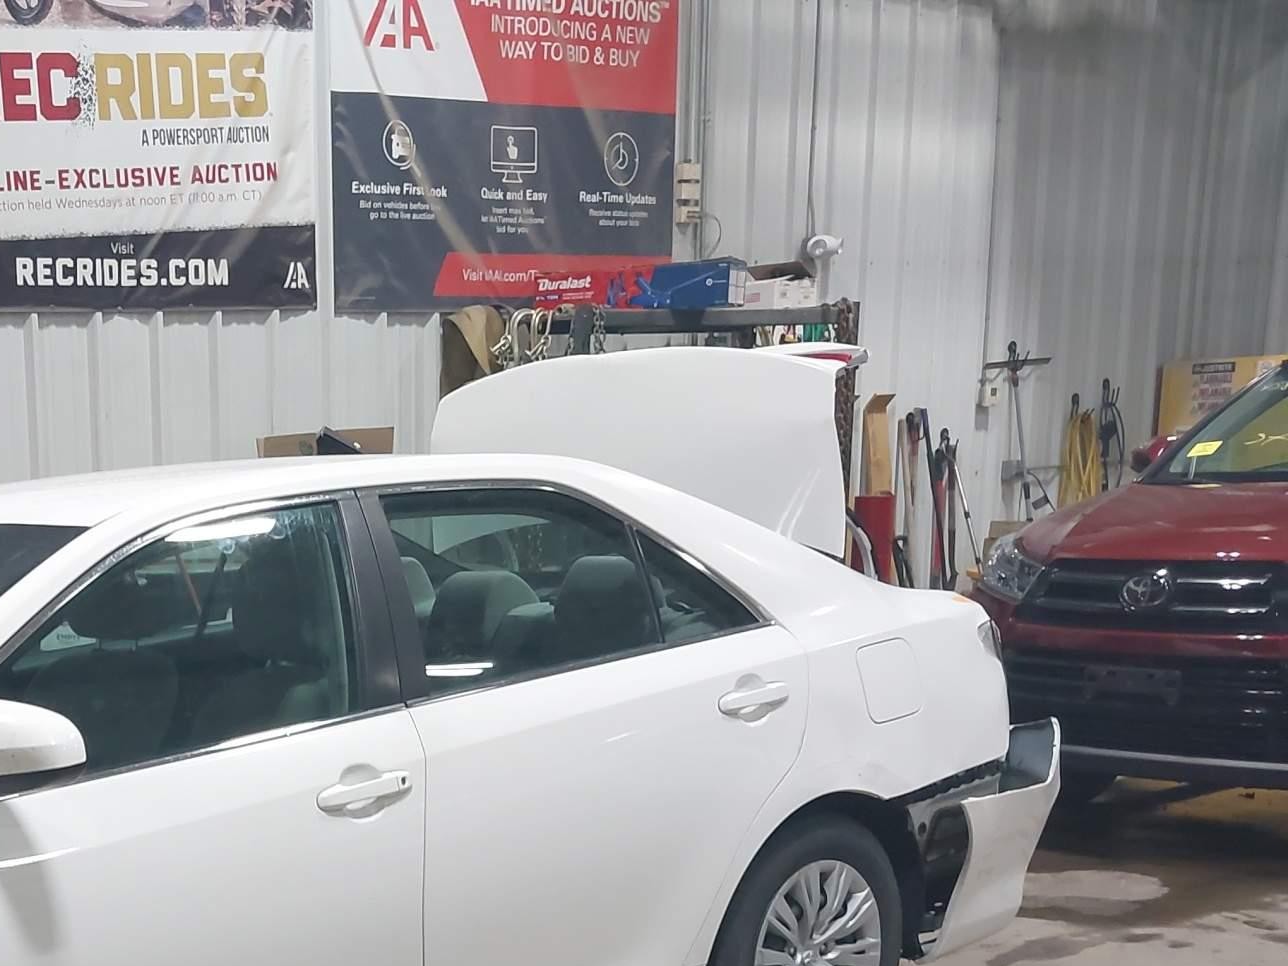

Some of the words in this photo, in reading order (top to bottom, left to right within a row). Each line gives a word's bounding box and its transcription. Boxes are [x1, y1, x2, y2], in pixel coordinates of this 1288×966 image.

[491, 14, 596, 41] INTRODUCING
[601, 25, 612, 42] A
[616, 25, 650, 44] NEW
[500, 40, 537, 59] WAY
[541, 42, 562, 61] TO
[566, 45, 589, 63] BID
[593, 47, 605, 65] &
[609, 48, 640, 67] BUY
[142, 129, 149, 146] A
[153, 126, 225, 146] POWERSPORT
[227, 125, 270, 144] AUCTION
[191, 162, 278, 184] AUCTION
[351, 181, 401, 195] Exclusive
[480, 186, 504, 200] Quick
[506, 189, 523, 200] and
[526, 189, 548, 203] Easy
[28, 198, 52, 210] held
[56, 195, 122, 210] Wednesdays
[126, 196, 136, 207] at
[140, 195, 167, 206] noon
[170, 193, 185, 205] ET
[188, 191, 215, 205] (1100
[243, 190, 262, 202] CT)
[579, 191, 624, 203] Real-Time
[625, 192, 656, 205] Updates
[111, 241, 134, 255] Visit
[15, 257, 229, 287] RECRIDES.COM
[462, 268, 482, 281] Visit
[538, 275, 591, 291] Duralast
